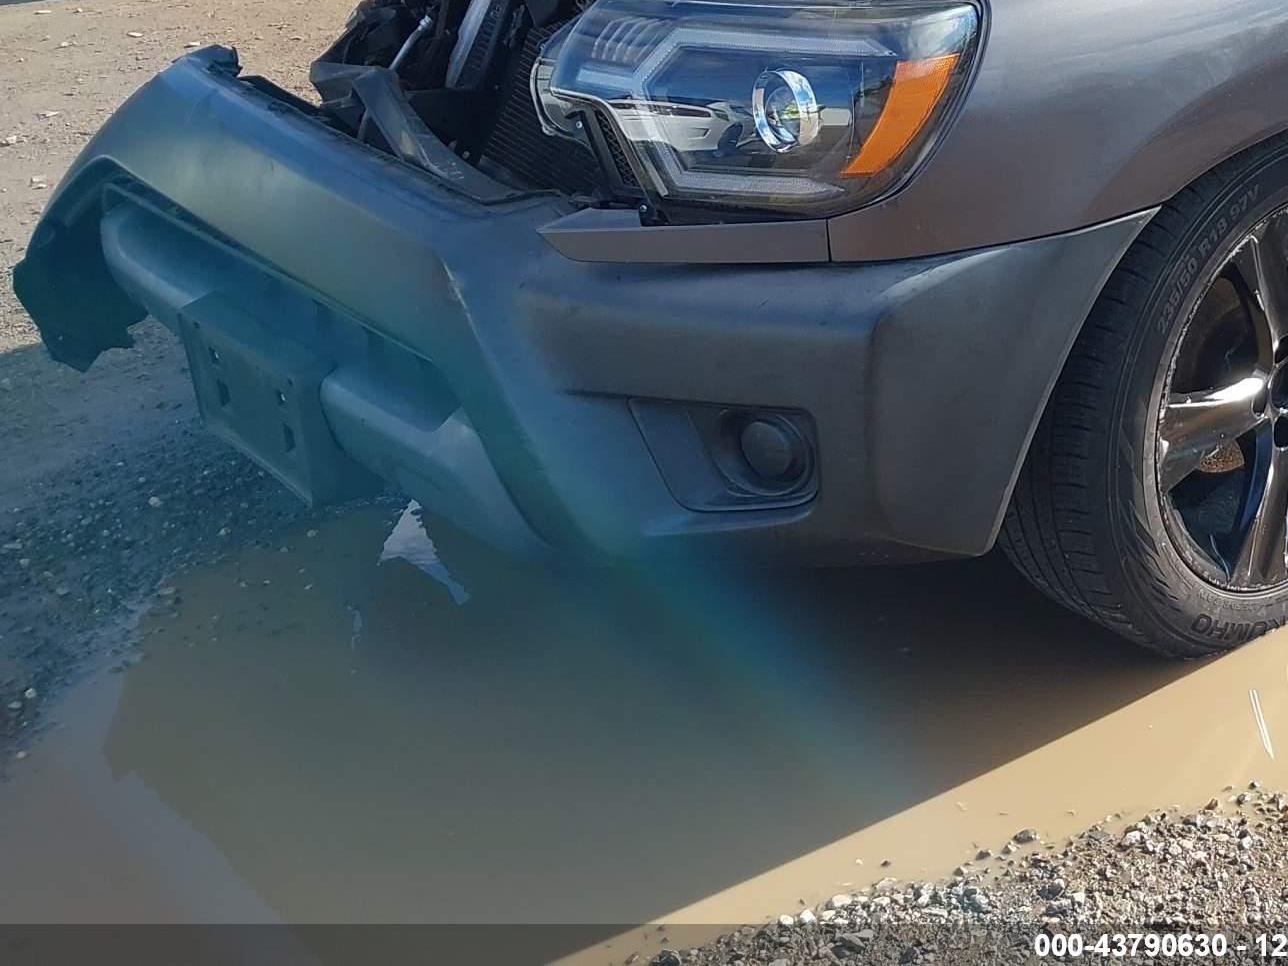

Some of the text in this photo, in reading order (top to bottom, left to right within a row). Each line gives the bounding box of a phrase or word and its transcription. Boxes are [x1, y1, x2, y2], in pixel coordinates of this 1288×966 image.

[1157, 184, 1260, 335] 235/50 R18 97V
